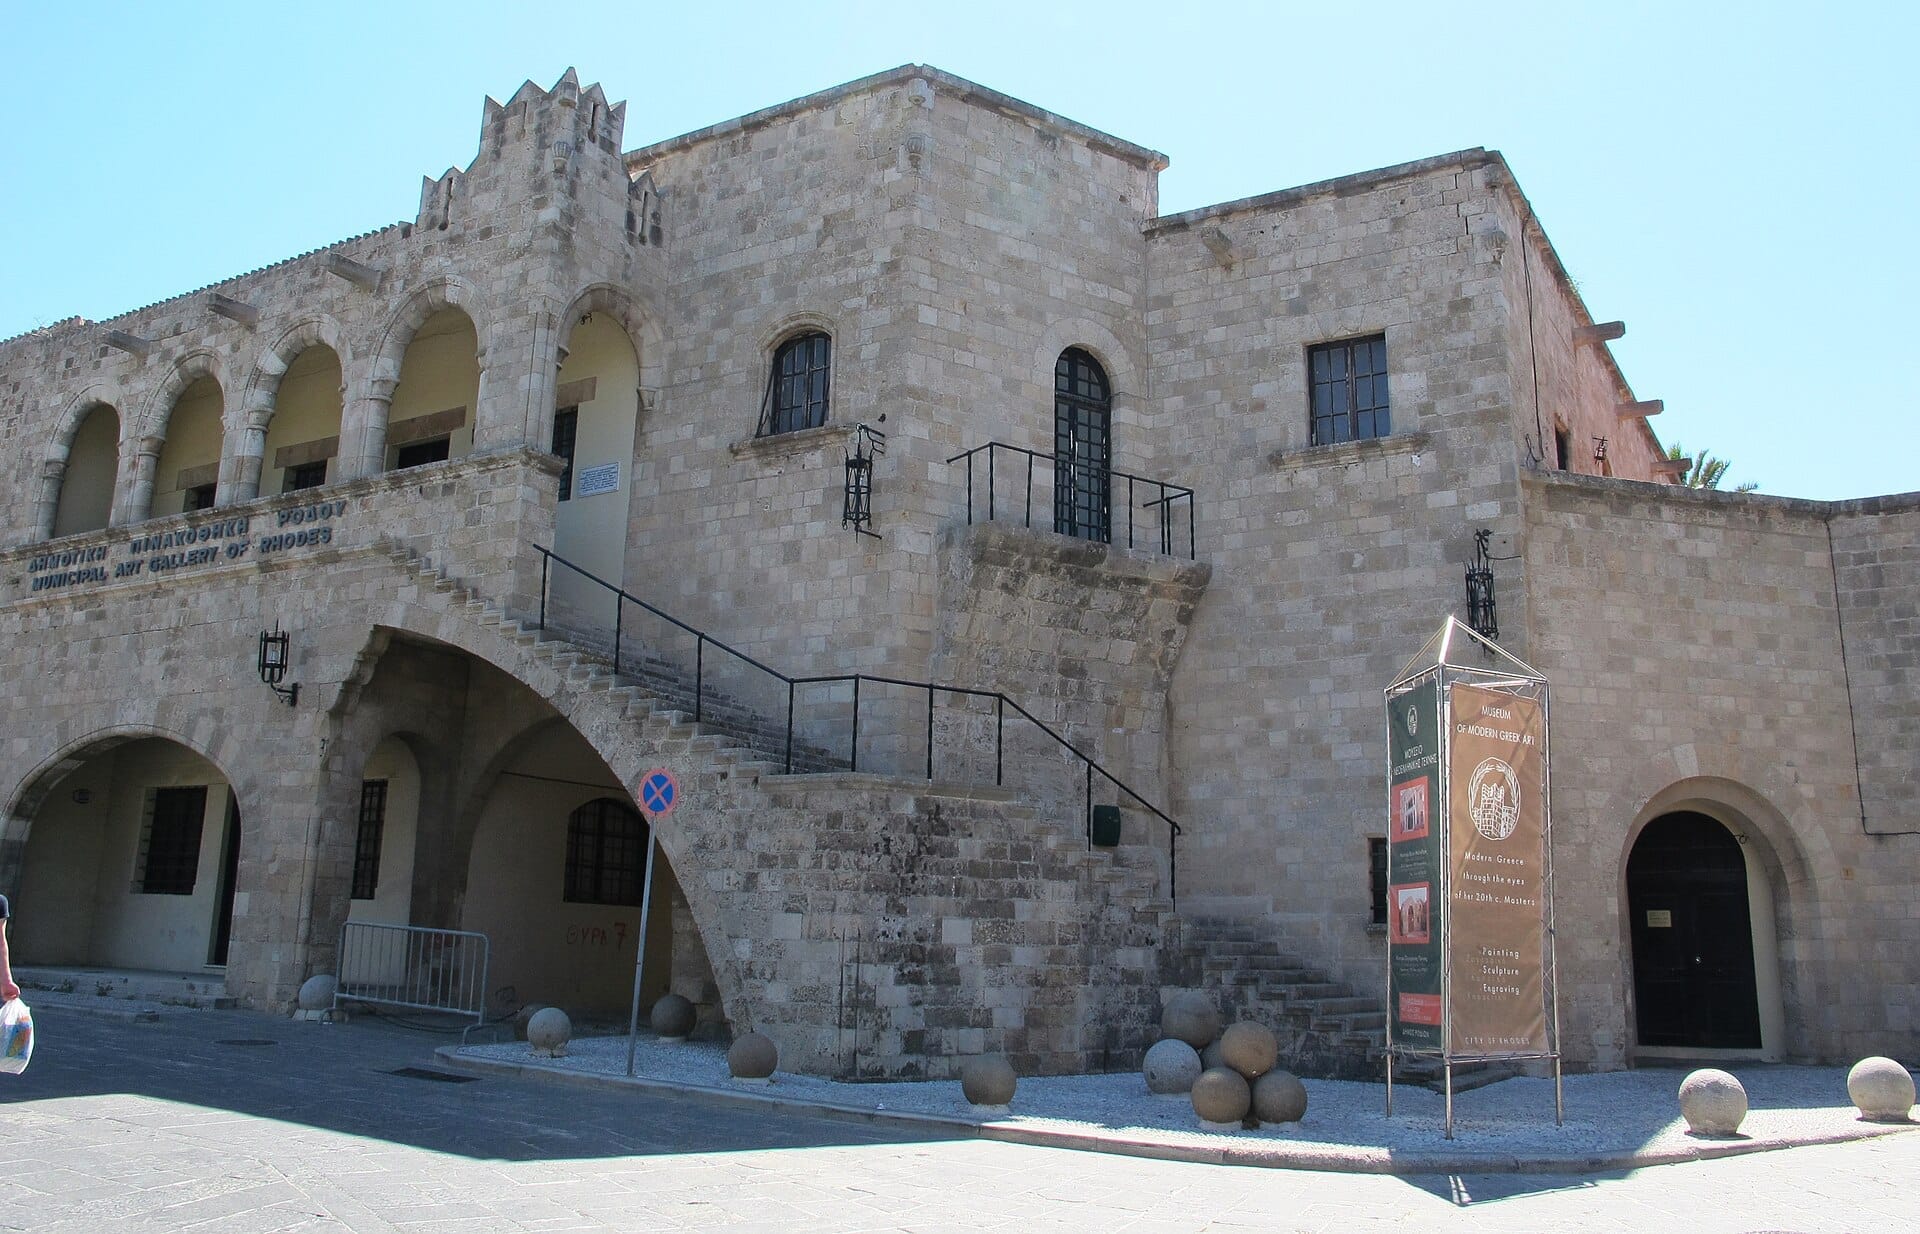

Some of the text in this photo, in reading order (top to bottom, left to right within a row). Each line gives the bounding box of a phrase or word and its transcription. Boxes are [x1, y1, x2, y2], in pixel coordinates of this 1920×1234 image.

[28, 500, 347, 573] ΔΗΜΟΤΙΚΗ ΠΙΝΑΚΟΘΗΚΗ ΡΟΔΟΥ
[32, 526, 333, 591] MUNICIPAL ART GALLERY OF RHODES
[1481, 705, 1511, 720] MUSEUM
[1456, 723, 1535, 746] OF MODERN GREEK ART
[1464, 851, 1524, 866] Modern Greece
[1463, 871, 1524, 886] through the eyes
[1455, 890, 1462, 899] of
[1464, 891, 1474, 901] her
[1475, 892, 1492, 902] 20th
[1504, 895, 1535, 906] Masters
[1482, 946, 1519, 960] Painting
[1482, 965, 1519, 977] Sculpture
[1483, 983, 1520, 996] Engraving
[1464, 1036, 1530, 1046] CITY OF RHODES
